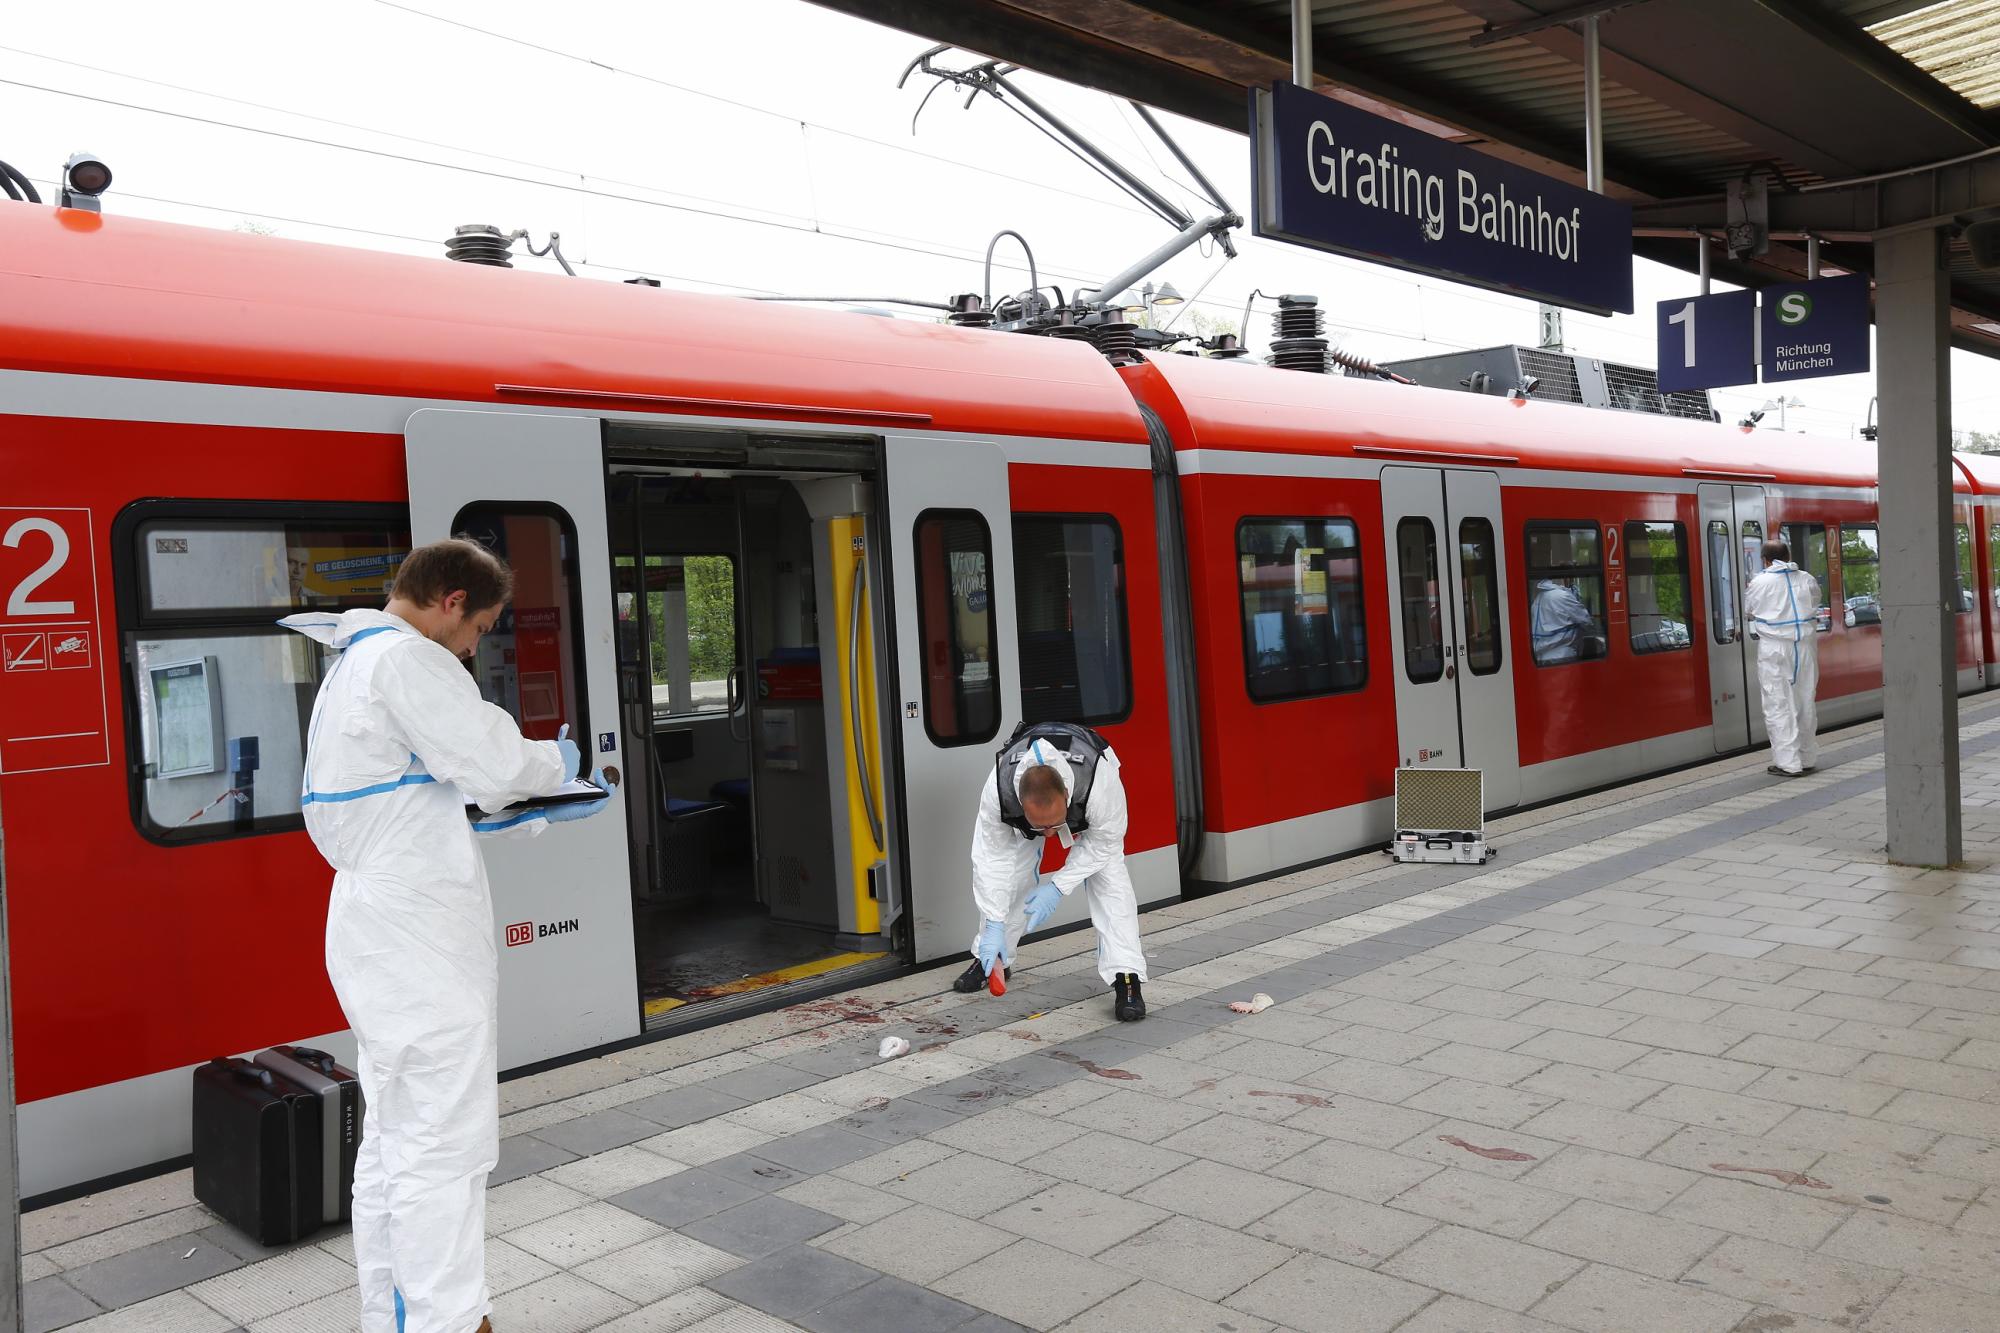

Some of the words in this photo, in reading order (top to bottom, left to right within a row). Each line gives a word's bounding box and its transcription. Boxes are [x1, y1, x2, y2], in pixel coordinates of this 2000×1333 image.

[1307, 120, 1444, 241] Grafing
[1458, 168, 1580, 263] Bahnhof
[1781, 294, 1807, 323] S
[1669, 302, 1696, 368] 1
[1776, 342, 1832, 358] Richtung
[1776, 356, 1834, 372] München
[1607, 527, 1619, 566] 2
[3, 517, 75, 616] 2
[315, 561, 330, 573] DIE
[1420, 750, 1428, 761] DB
[1429, 750, 1443, 759] BAHN
[507, 923, 533, 945] DB
[538, 919, 579, 937] BAHN
